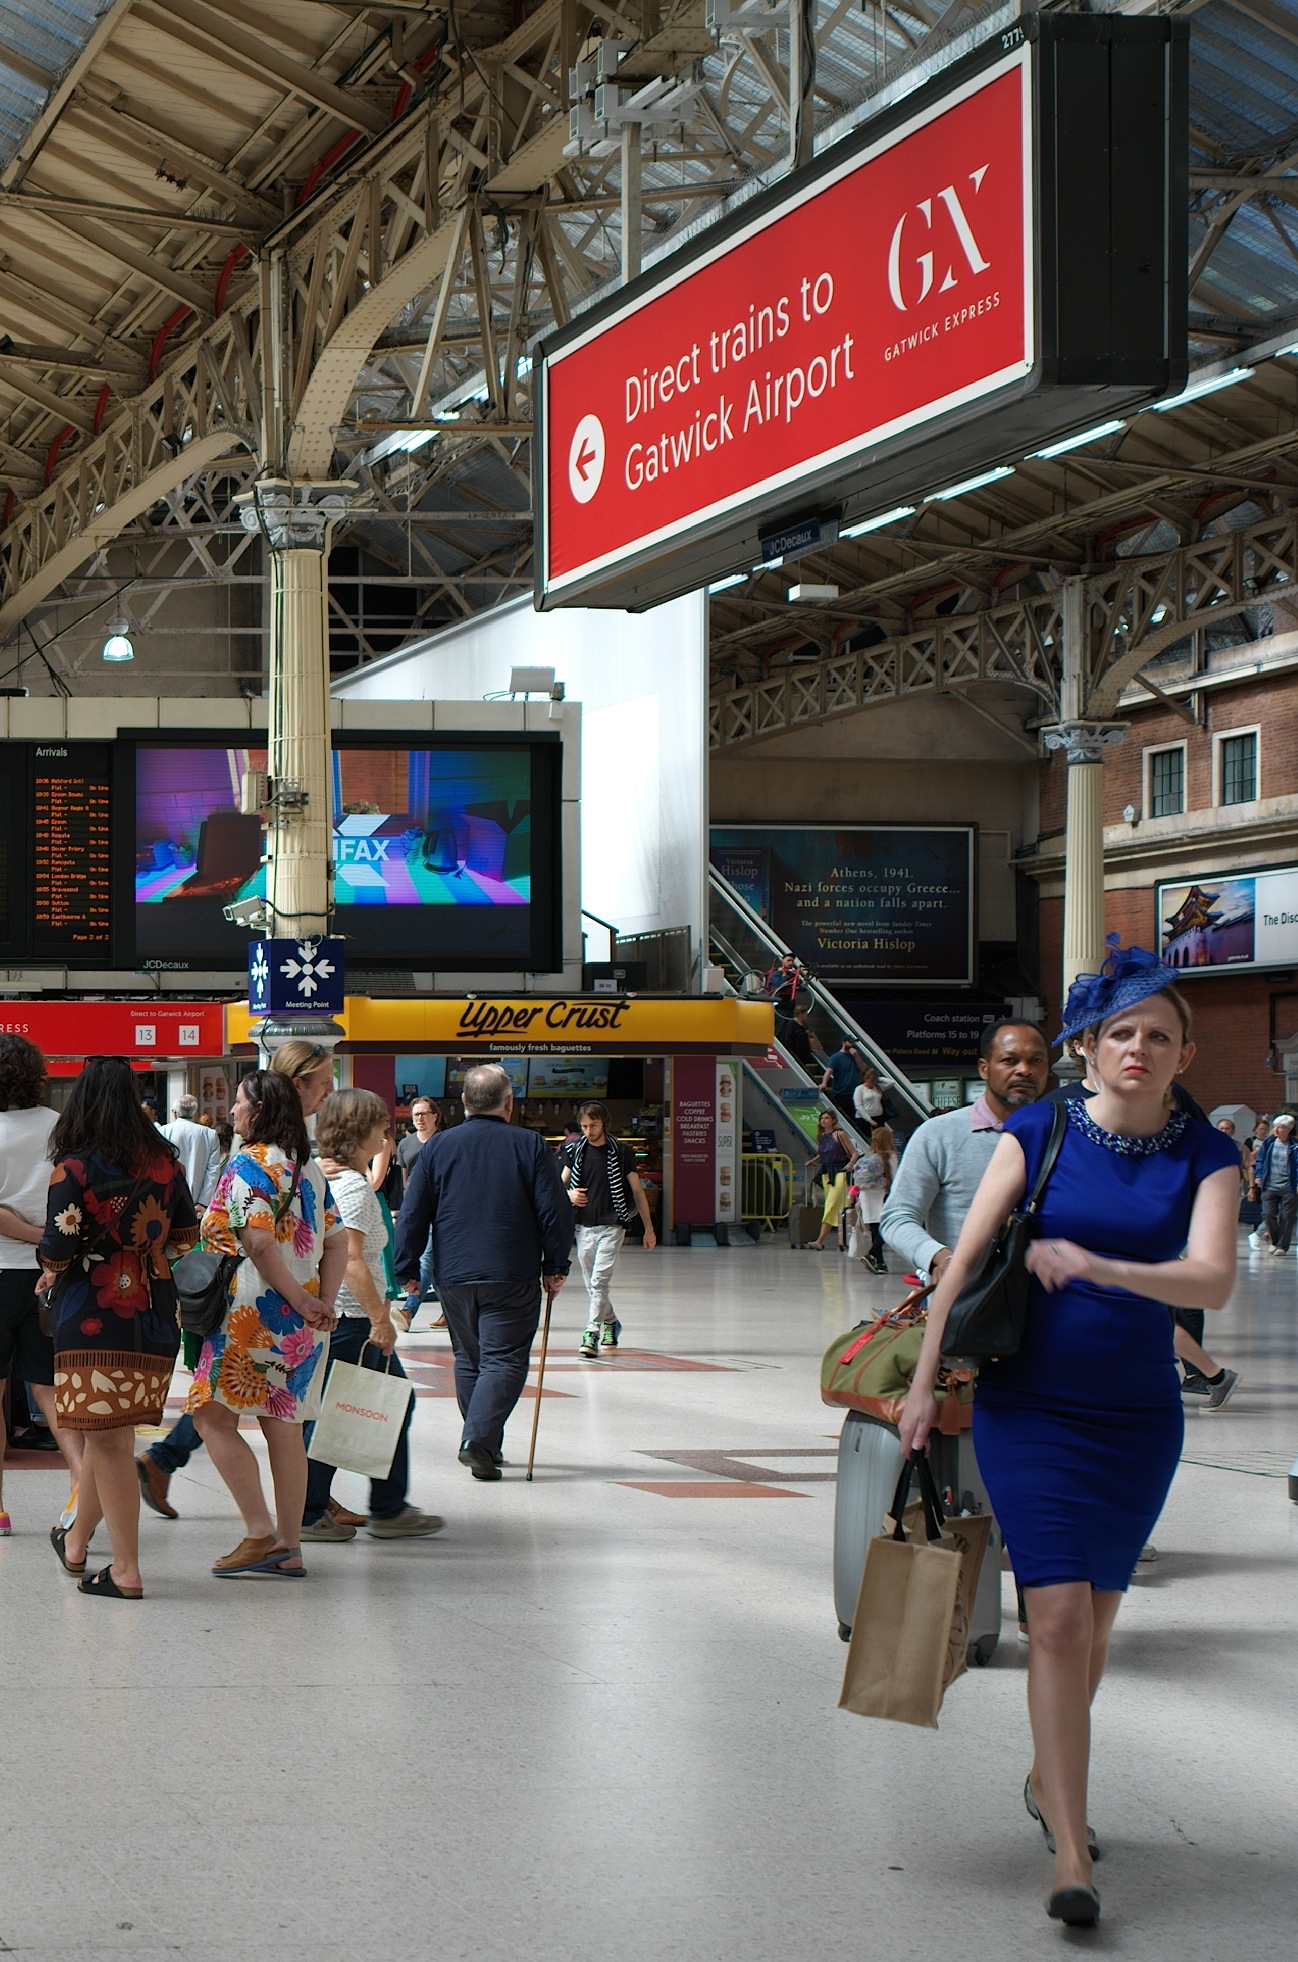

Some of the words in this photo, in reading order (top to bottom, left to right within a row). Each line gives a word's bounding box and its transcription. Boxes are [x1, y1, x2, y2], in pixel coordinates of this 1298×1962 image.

[888, 163, 991, 311] GX
[884, 322, 939, 362] GATWICK
[944, 291, 1001, 332] EXPRESS
[625, 343, 701, 424] Direct
[709, 296, 790, 374] trains
[800, 271, 835, 323] to
[624, 394, 735, 491] Gatwick
[742, 332, 855, 434] Airport
[769, 530, 812, 556] JCDecaux
[35, 748, 68, 757] Arrivals
[722, 865, 758, 879] Hislop
[830, 867, 878, 879] Athens,
[883, 867, 915, 879] 1941.
[730, 881, 755, 891] hose
[784, 882, 812, 893] Nazi
[818, 882, 854, 893] forces
[859, 885, 902, 896] occupy
[907, 882, 960, 894] Greece...
[797, 897, 819, 908] and
[824, 900, 831, 908] a
[836, 898, 875, 908] nation
[880, 897, 907, 908] falls
[911, 900, 948, 911] apart.
[892, 920, 912, 928] Sunday
[1264, 914, 1278, 926] The
[1281, 912, 1298, 924] Disc
[817, 937, 869, 949] Victoria
[874, 937, 916, 953] Hislop
[142, 960, 189, 969] JCDecaux
[183, 1010, 205, 1018] Airport
[456, 1002, 543, 1038] Upper
[545, 1001, 631, 1029] Crust
[924, 1014, 950, 1022] Coach
[951, 1014, 980, 1022] station
[139, 1030, 152, 1040] 13
[182, 1030, 195, 1040] 14
[906, 1030, 946, 1038] Platforms
[970, 1031, 980, 1039] 19
[489, 1043, 526, 1053] famously
[528, 1043, 548, 1051] fresh
[550, 1043, 592, 1052] baguettes
[942, 1047, 960, 1057] Way
[933, 1096, 961, 1108] CHEESE
[718, 1136, 732, 1147] SUPER
[336, 1402, 388, 1422] MONSOON
